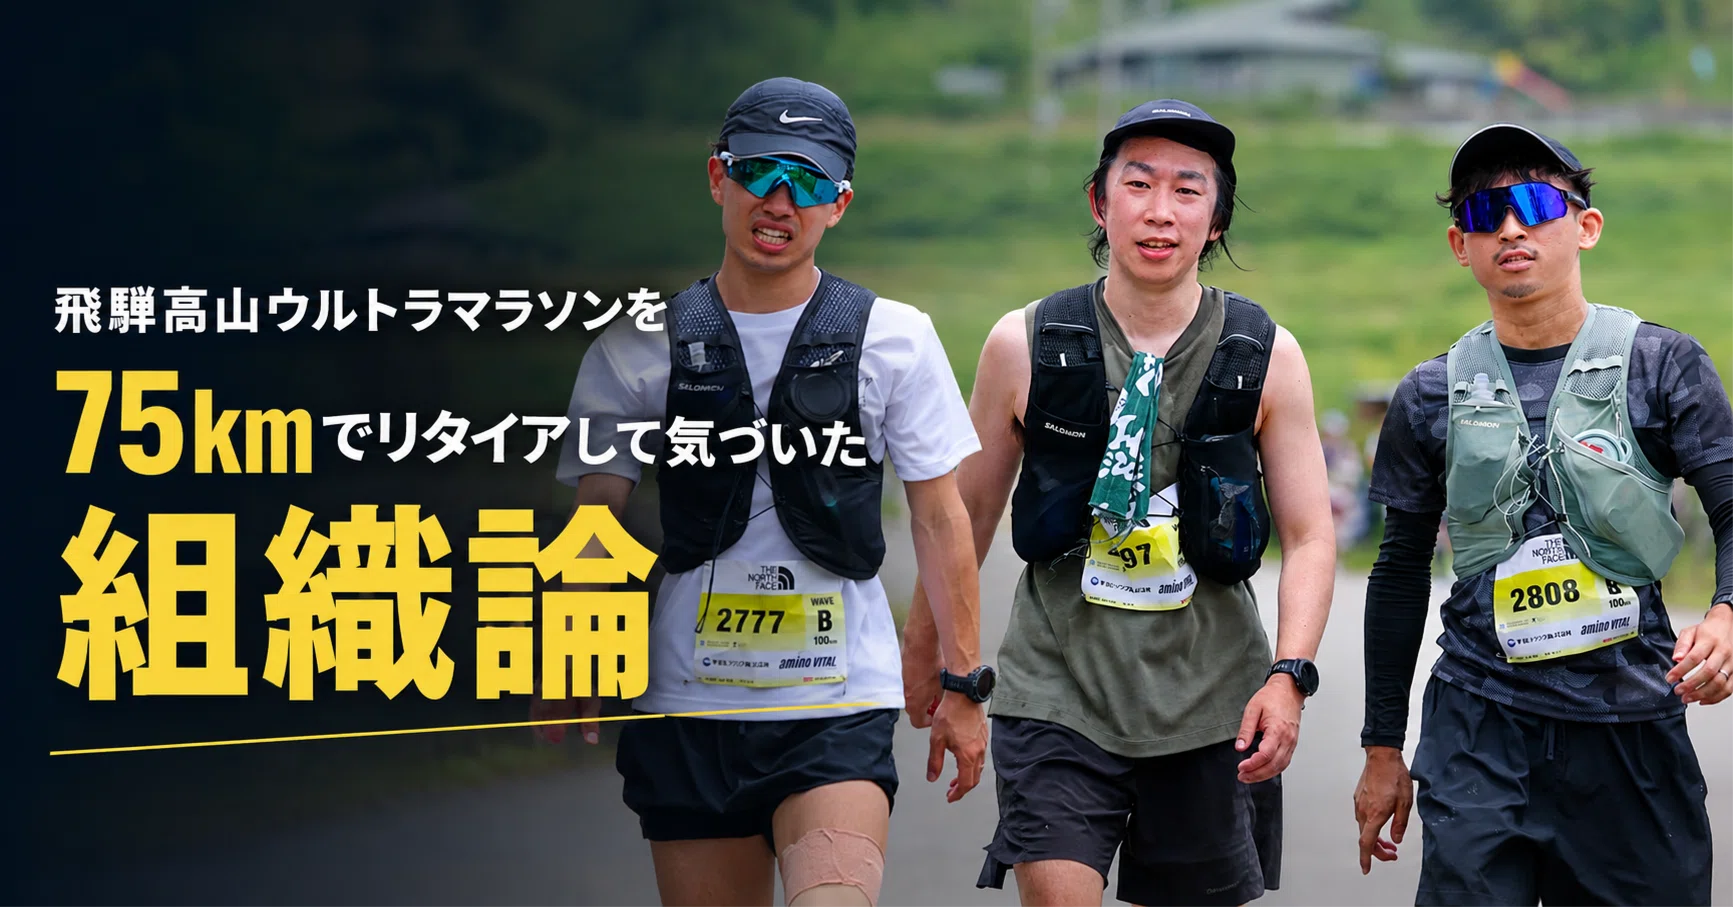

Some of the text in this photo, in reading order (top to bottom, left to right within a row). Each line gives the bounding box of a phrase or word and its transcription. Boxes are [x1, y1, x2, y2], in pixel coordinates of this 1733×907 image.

[1542, 554, 1565, 564] FACE
[760, 565, 777, 574] THE
[748, 573, 778, 582] NORTH
[755, 581, 778, 590] FACE
[1158, 579, 1183, 594] amino
[1605, 578, 1622, 595] B
[810, 597, 834, 606] WAVE
[1510, 578, 1580, 613] 2808
[716, 608, 785, 634] 2777
[818, 610, 833, 632] B
[1580, 616, 1630, 636] amino VITAL
[779, 655, 811, 669] amino
[813, 655, 836, 668] VITAL
